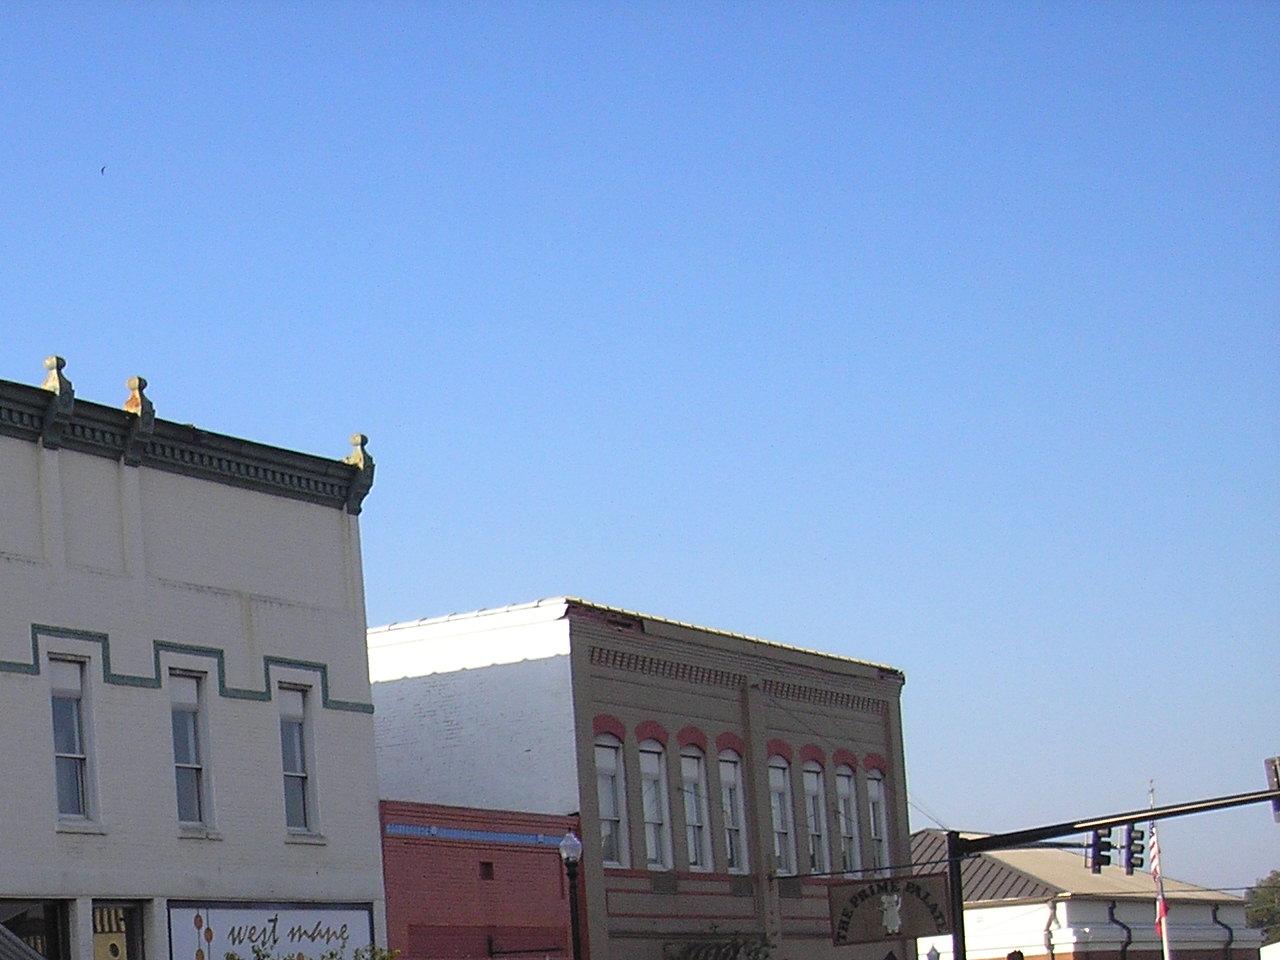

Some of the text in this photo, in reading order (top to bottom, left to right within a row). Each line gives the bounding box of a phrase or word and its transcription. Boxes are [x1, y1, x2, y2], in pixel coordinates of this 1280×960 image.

[849, 881, 901, 909] PRIME
[227, 912, 350, 947] west mane
